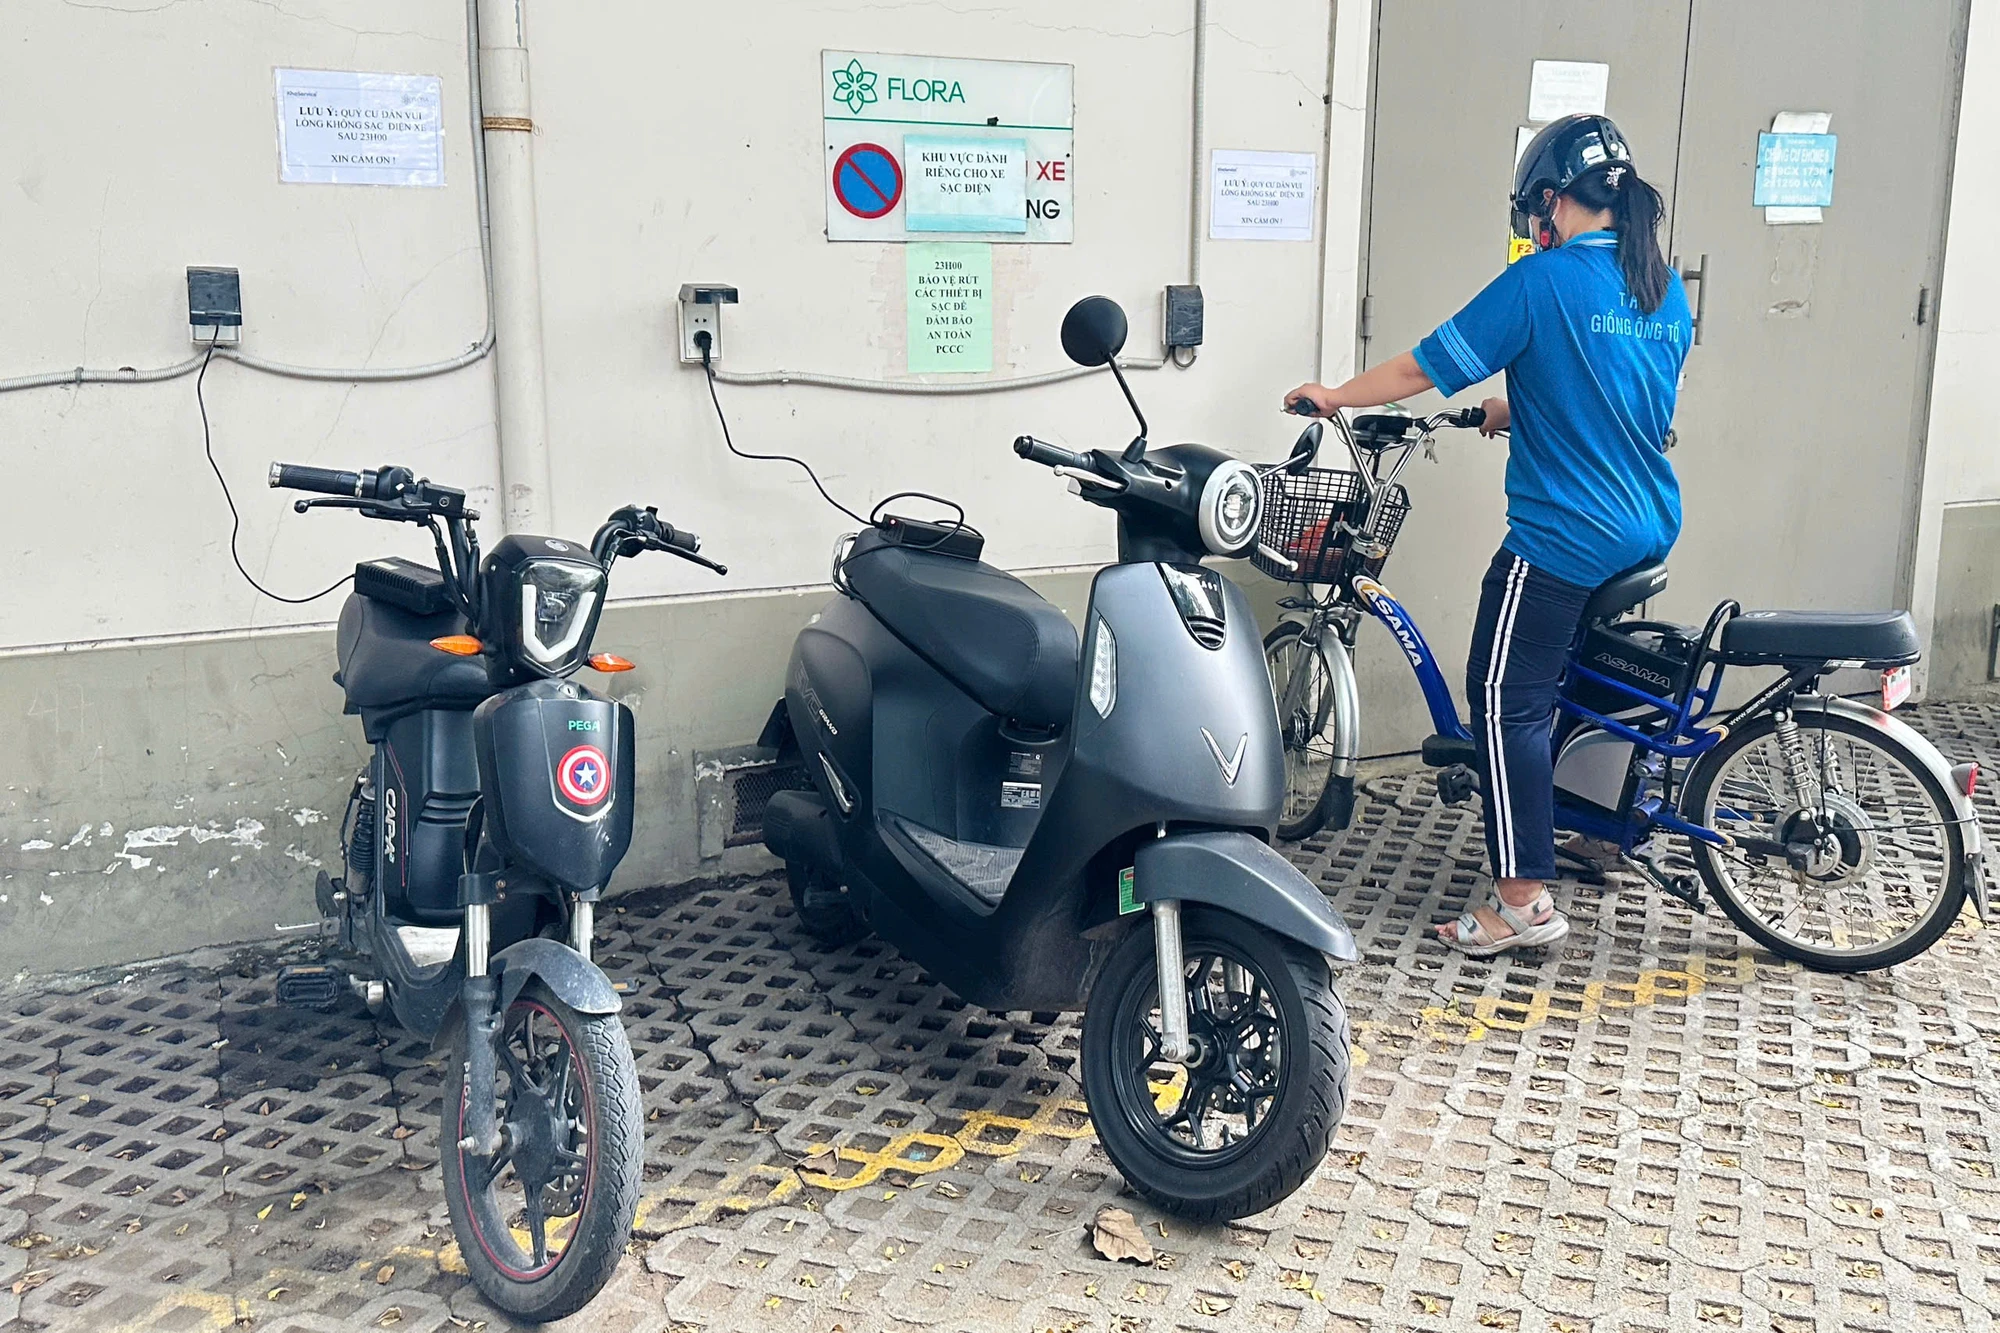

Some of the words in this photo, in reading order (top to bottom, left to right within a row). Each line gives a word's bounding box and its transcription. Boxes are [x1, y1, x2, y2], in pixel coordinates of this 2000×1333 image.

[888, 77, 966, 104] FLORA
[404, 112, 422, 120] VUI
[326, 119, 362, 130] KHÔNG
[338, 132, 358, 141] SAU
[360, 132, 388, 142] 23H00
[331, 154, 348, 164] XIN
[922, 152, 946, 162] KHU
[950, 152, 974, 165] VỰC
[976, 152, 1008, 164] DÀNH
[925, 165, 961, 178] RIÊNG
[963, 168, 988, 179] CHO
[990, 169, 1006, 179] XE
[1036, 160, 1066, 181] XE
[940, 182, 962, 195] SẠC
[964, 182, 992, 196] ĐIỆN
[1290, 182, 1303, 190] VUI
[1026, 198, 1061, 220] NG
[1517, 244, 1533, 254] F2
[934, 261, 962, 270] 23H00
[942, 275, 956, 286] VỆ
[958, 274, 979, 284] RÚT
[914, 287, 936, 298] CÁC
[972, 289, 982, 300] BỊ
[931, 302, 951, 313] SẠC
[1591, 309, 1632, 336] GIỒNG
[1634, 316, 1663, 341] ÔNG
[1667, 320, 1680, 344] TỐ
[927, 332, 941, 340] AN
[944, 328, 972, 340] TOÀN
[936, 345, 964, 354] PCCC
[1362, 588, 1423, 668] ASAMA
[1594, 652, 1670, 689] ASAMA
[568, 720, 600, 732] PEGA
[818, 708, 838, 735] GRAND
